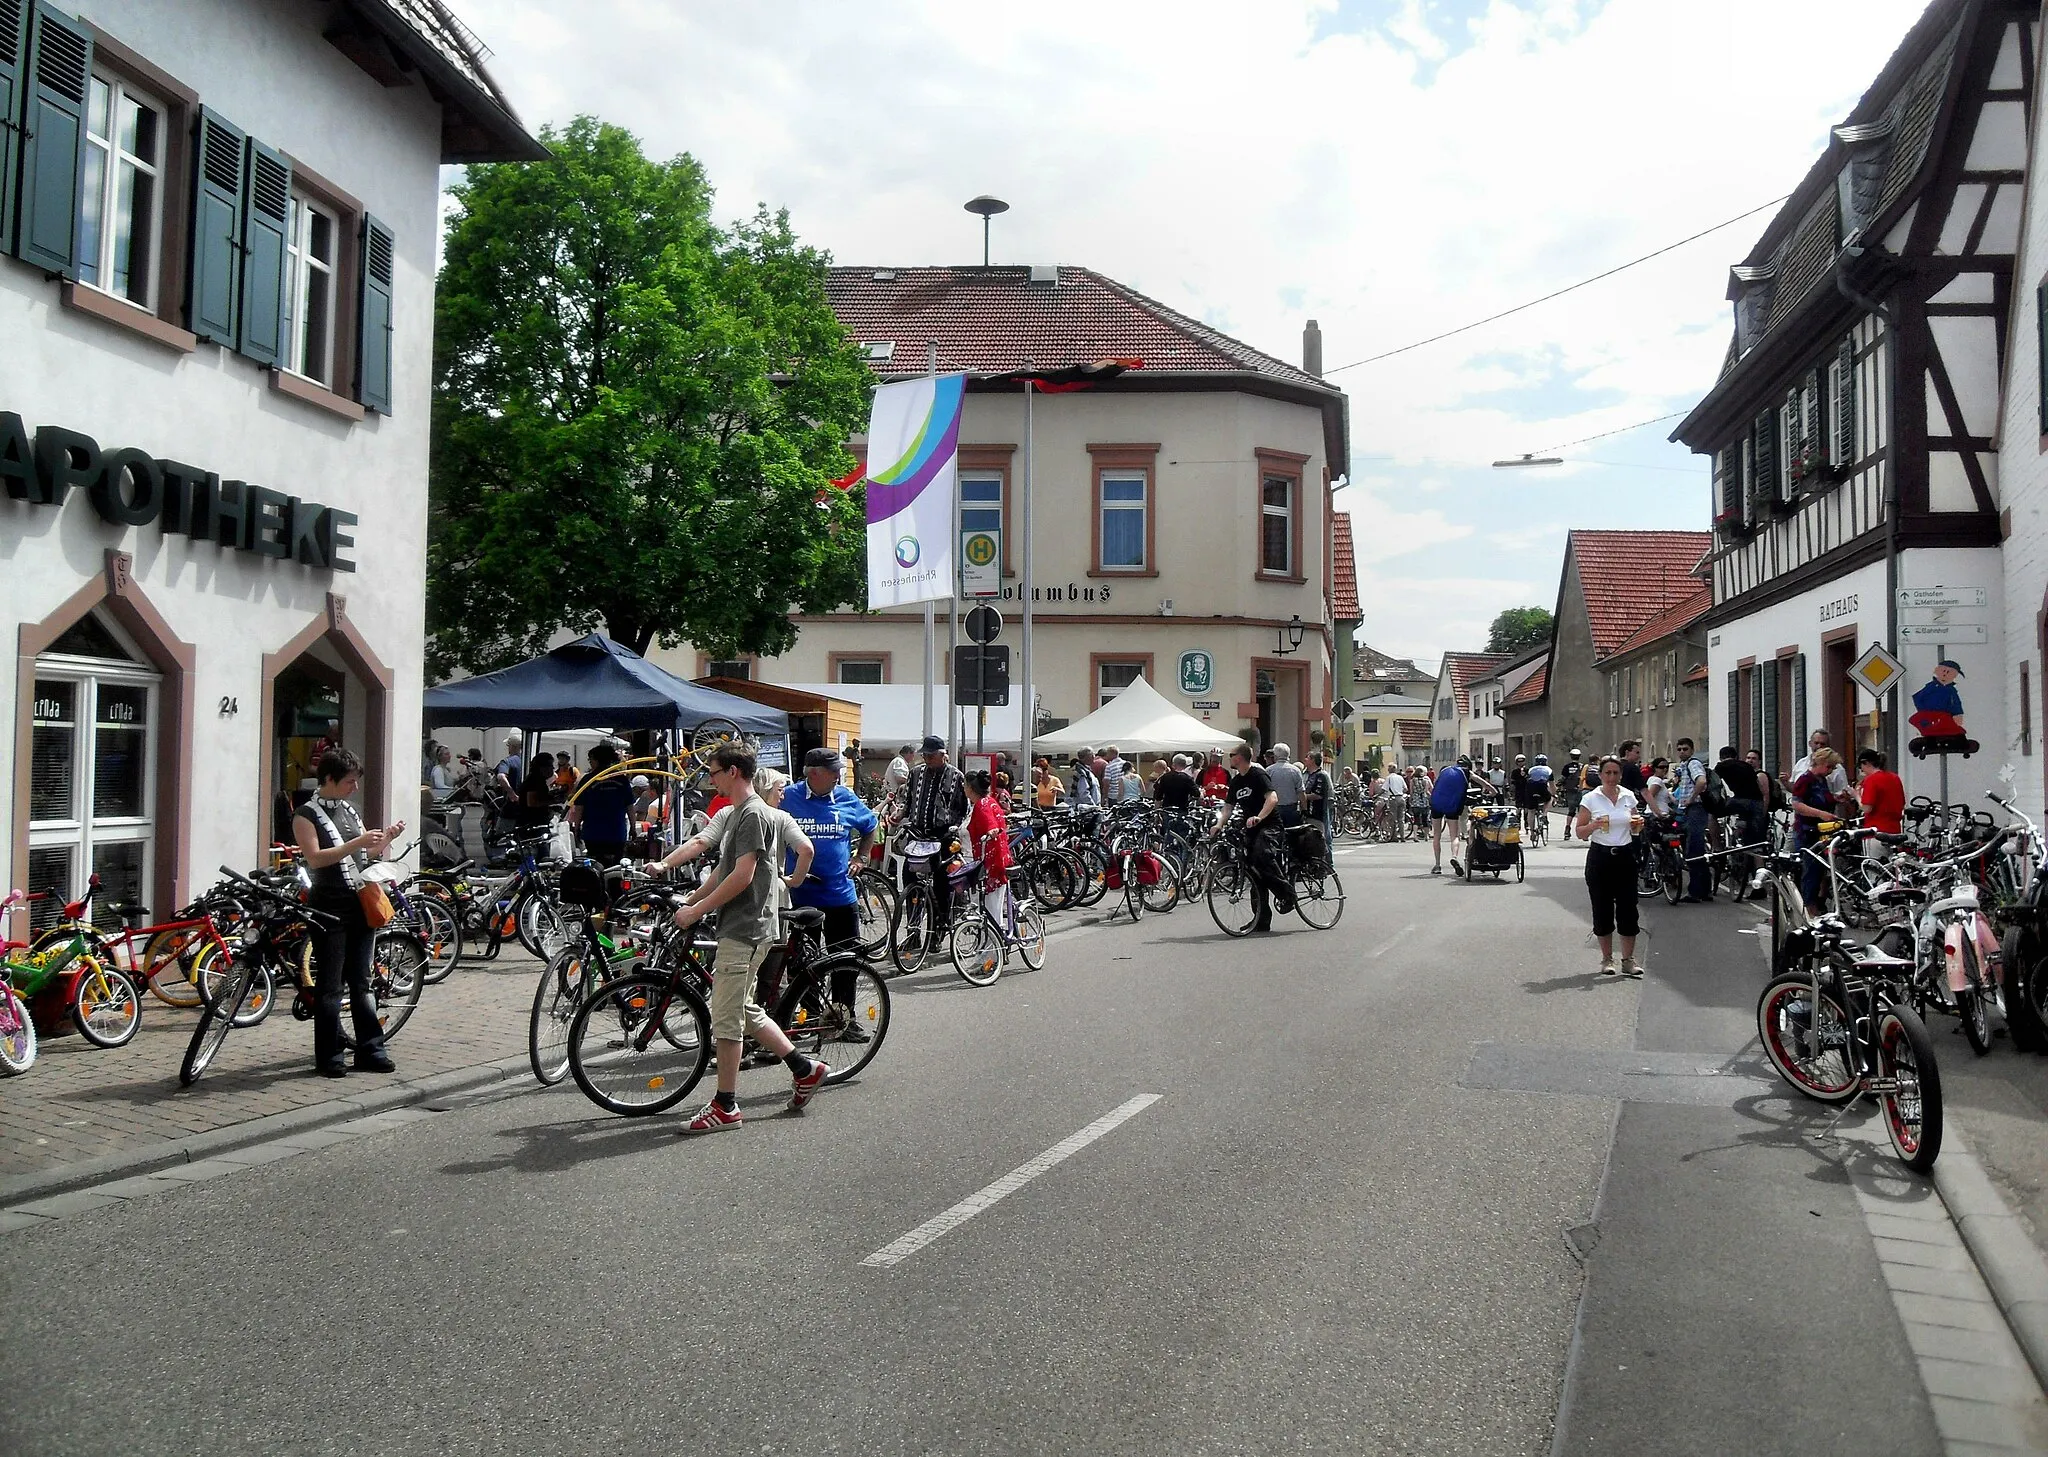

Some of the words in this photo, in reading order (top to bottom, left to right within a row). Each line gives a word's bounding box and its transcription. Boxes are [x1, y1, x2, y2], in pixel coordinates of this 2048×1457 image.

[0, 410, 358, 573] APOTHEKE
[974, 541, 988, 558] H
[1002, 582, 1112, 602] olumbus
[1819, 594, 1859, 622] RATHAUS
[221, 696, 238, 714] 24
